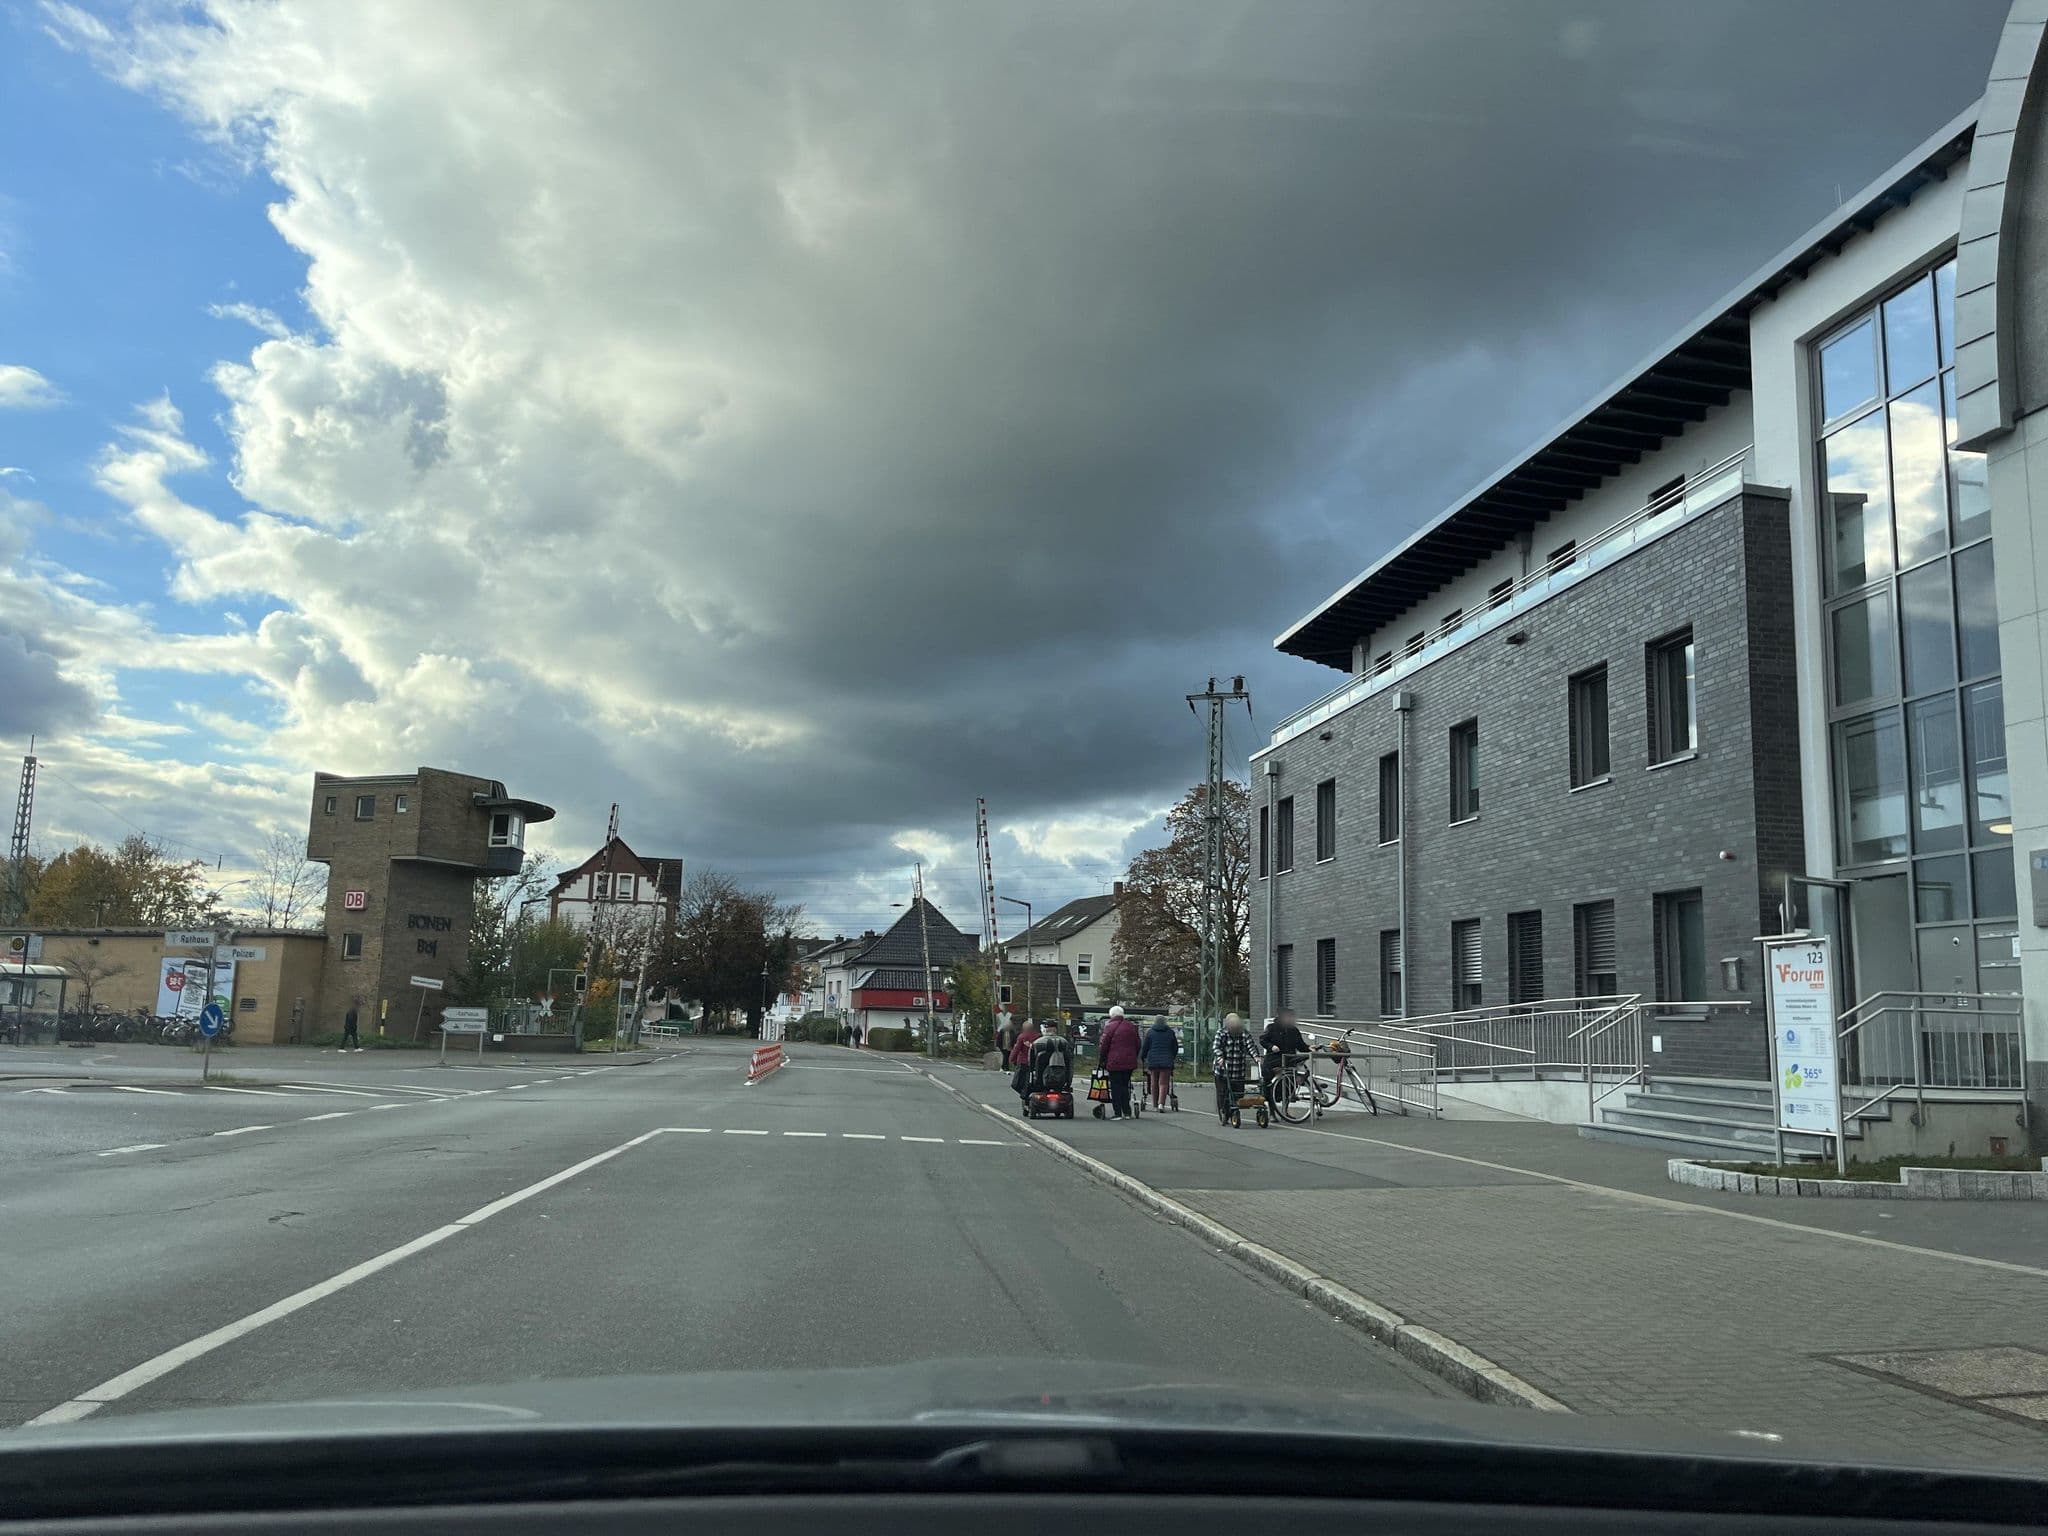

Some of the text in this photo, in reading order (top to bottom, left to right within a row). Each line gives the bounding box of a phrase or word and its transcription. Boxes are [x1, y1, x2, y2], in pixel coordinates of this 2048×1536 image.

[346, 893, 363, 907] DB
[180, 934, 209, 944] Rathaus
[232, 948, 256, 958] Polizei
[1807, 951, 1823, 964] 123
